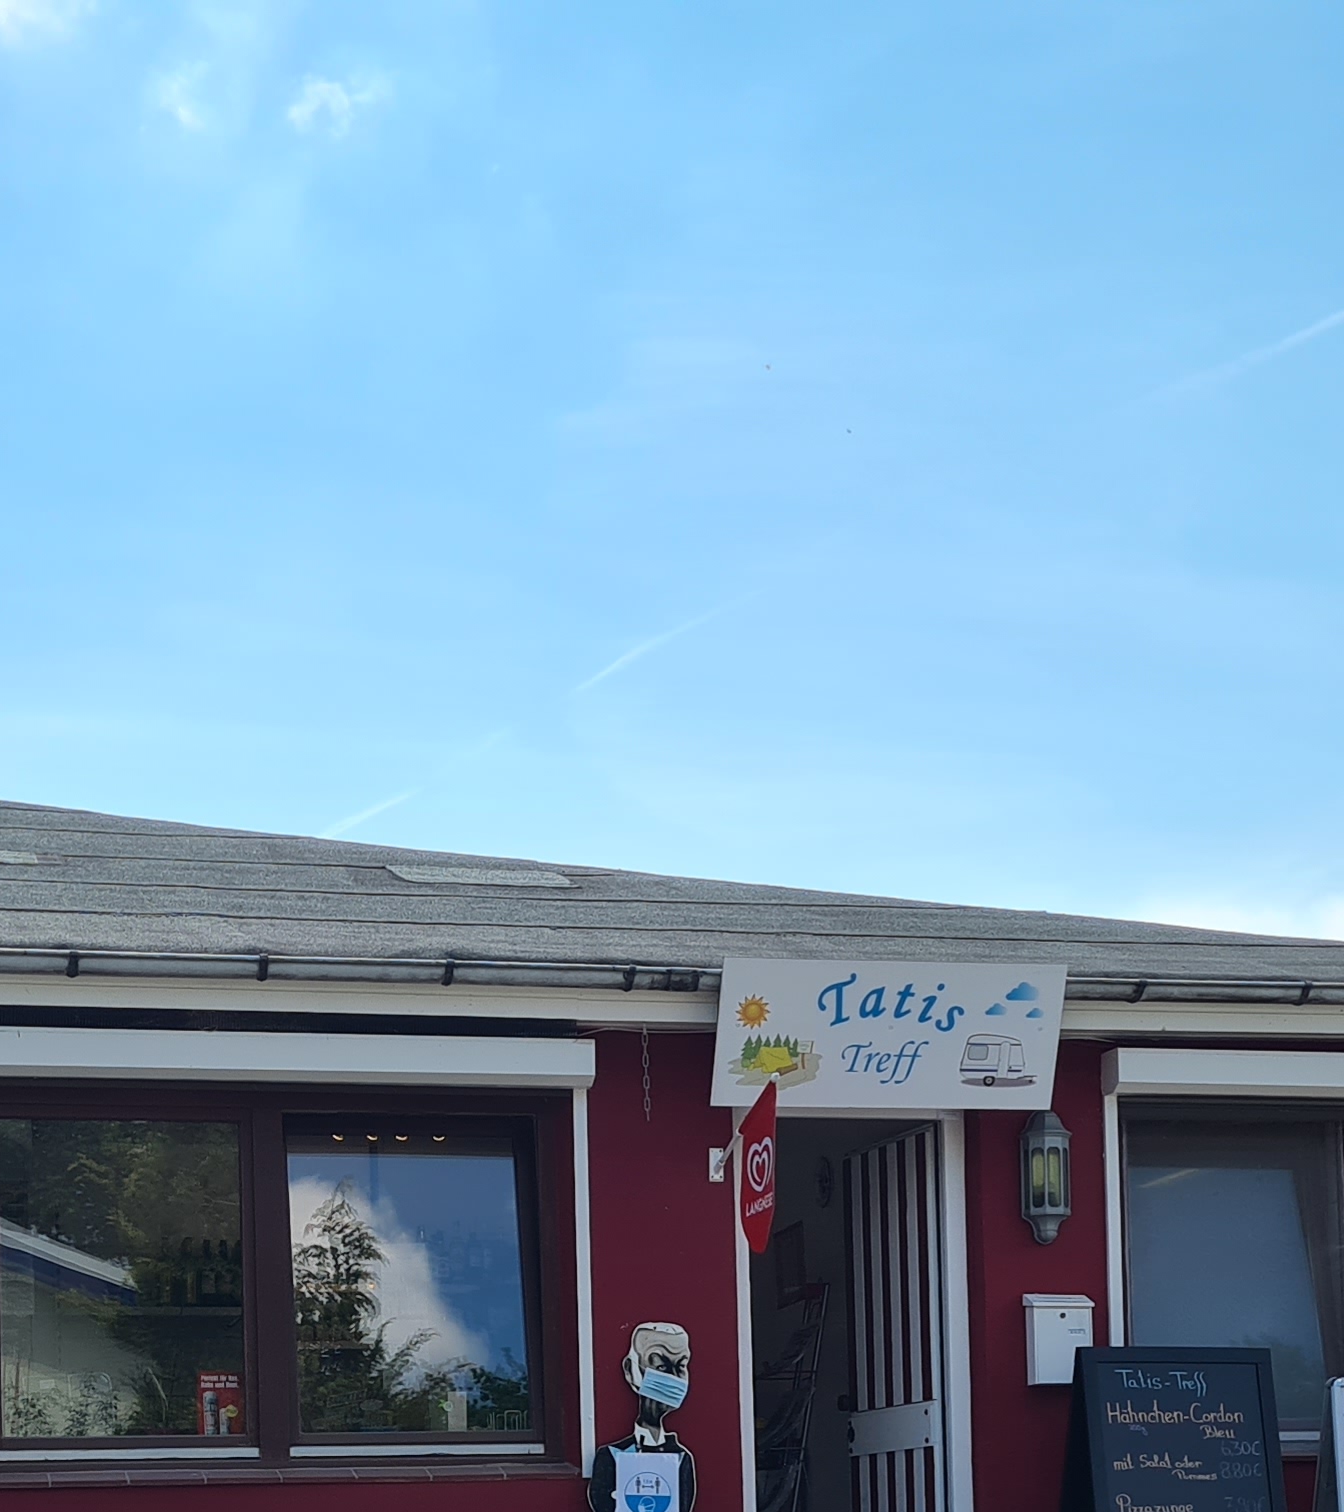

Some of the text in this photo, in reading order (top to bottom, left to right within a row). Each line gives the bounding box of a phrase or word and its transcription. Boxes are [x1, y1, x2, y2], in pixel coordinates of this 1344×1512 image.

[817, 972, 965, 1033] Tatis
[841, 1040, 930, 1085] Treff
[1200, 1425, 1236, 1439] Bleu
[1113, 1452, 1203, 1471] mit Salat oder
